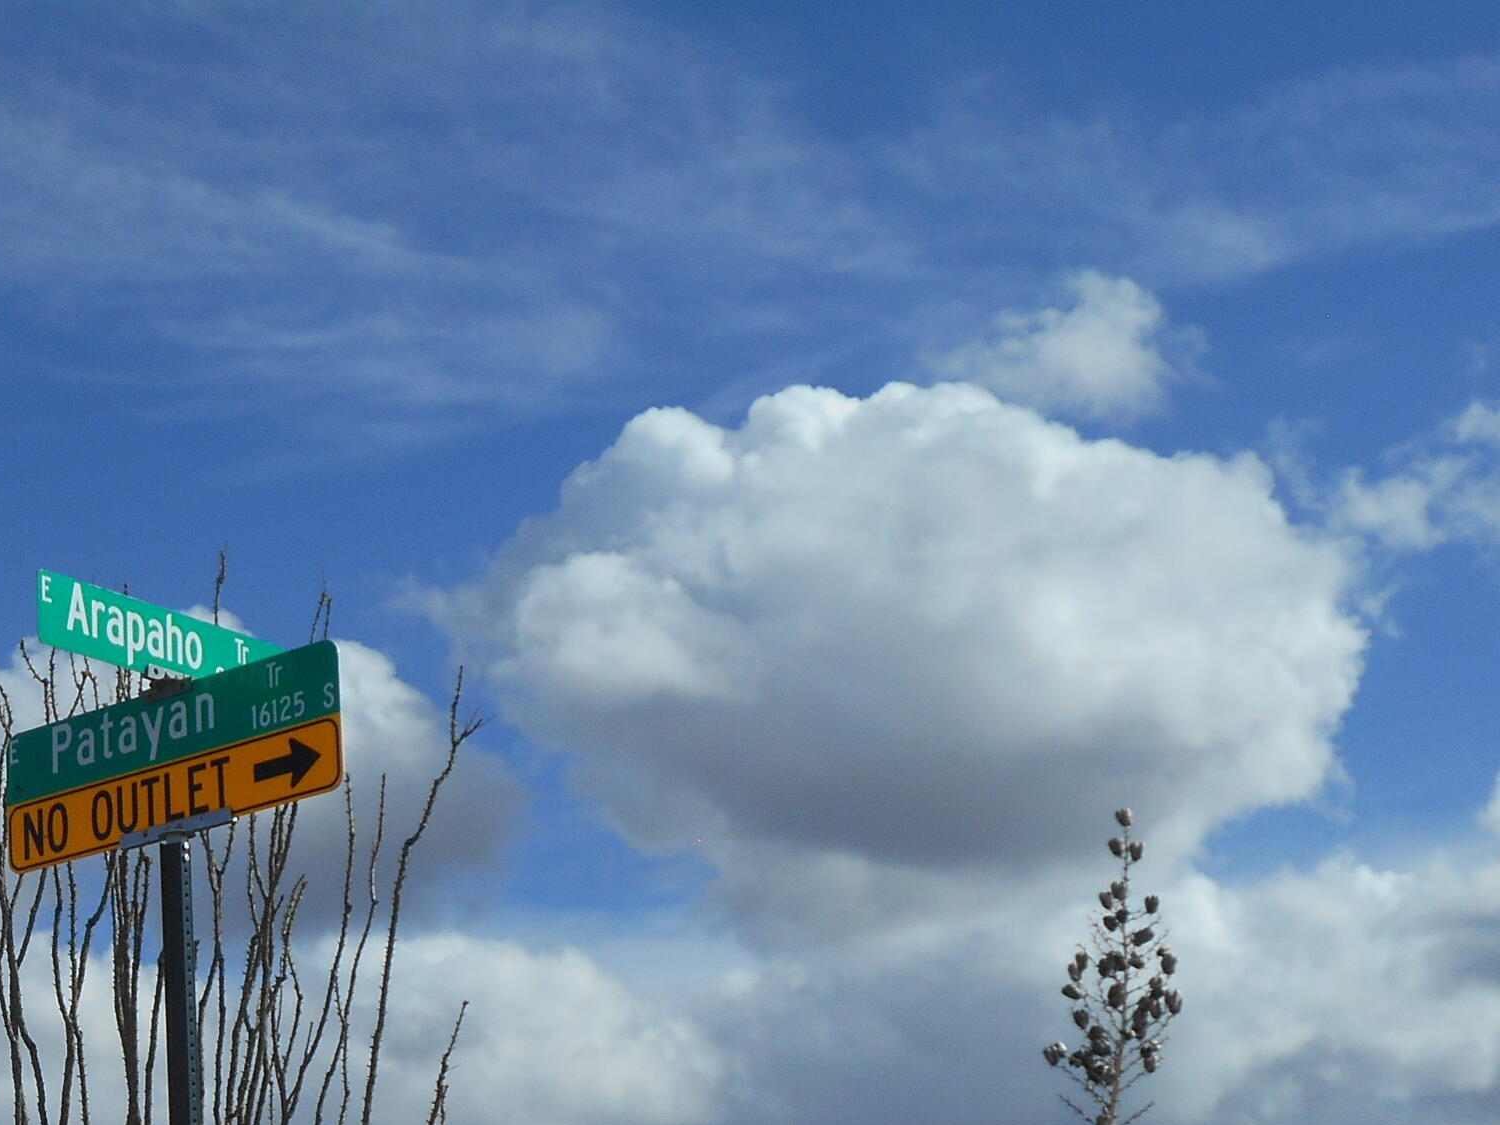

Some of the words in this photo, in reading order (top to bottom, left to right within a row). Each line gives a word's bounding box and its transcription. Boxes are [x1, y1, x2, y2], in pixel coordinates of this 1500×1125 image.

[41, 575, 52, 603] E
[66, 582, 203, 670] Arapaho
[234, 637, 250, 666] Tr
[8, 738, 19, 765] E
[52, 692, 215, 775] Patayan
[266, 661, 283, 689] Tr
[251, 690, 306, 730] 16125
[323, 682, 335, 709] S
[23, 802, 69, 861] NO
[91, 755, 231, 841] OUTLET
